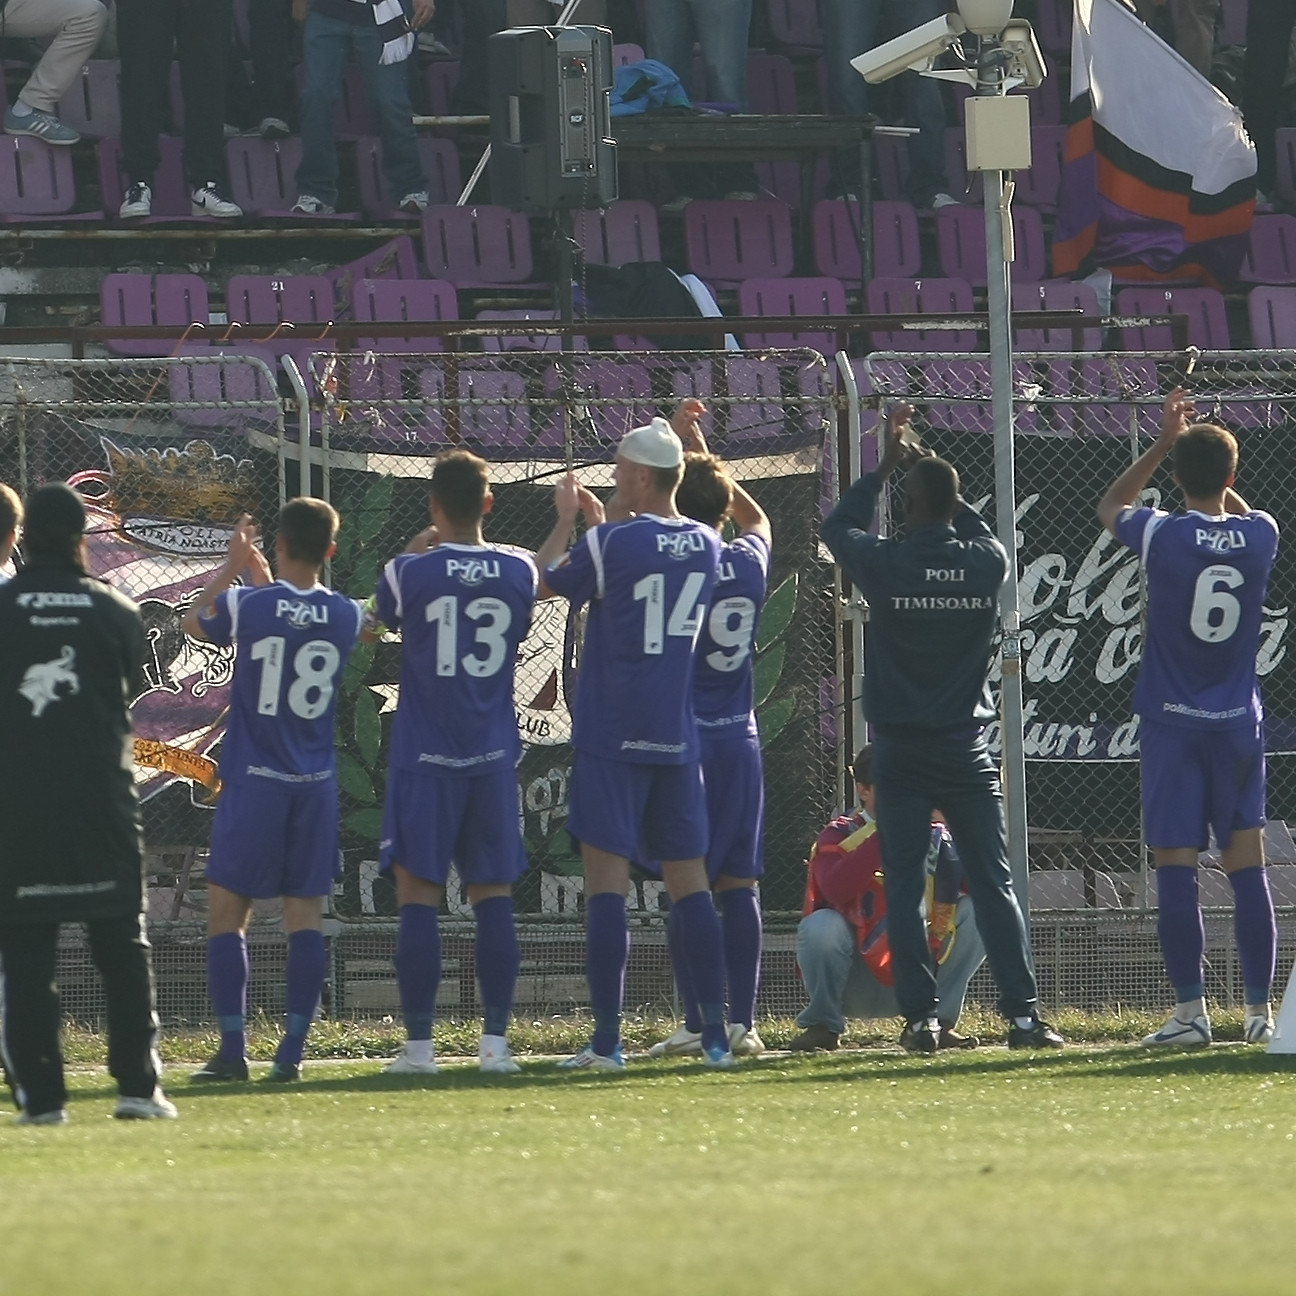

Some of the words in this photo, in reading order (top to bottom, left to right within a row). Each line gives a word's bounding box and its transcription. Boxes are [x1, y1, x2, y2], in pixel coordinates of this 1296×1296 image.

[271, 281, 285, 291] 21
[914, 280, 922, 291] 7
[924, 568, 965, 583] POLI
[632, 571, 706, 655] 14
[891, 596, 994, 610] TIMISOARA
[1189, 564, 1245, 644] 6
[424, 594, 513, 678] 13
[249, 635, 341, 721] 18
[517, 711, 551, 737] LUB
